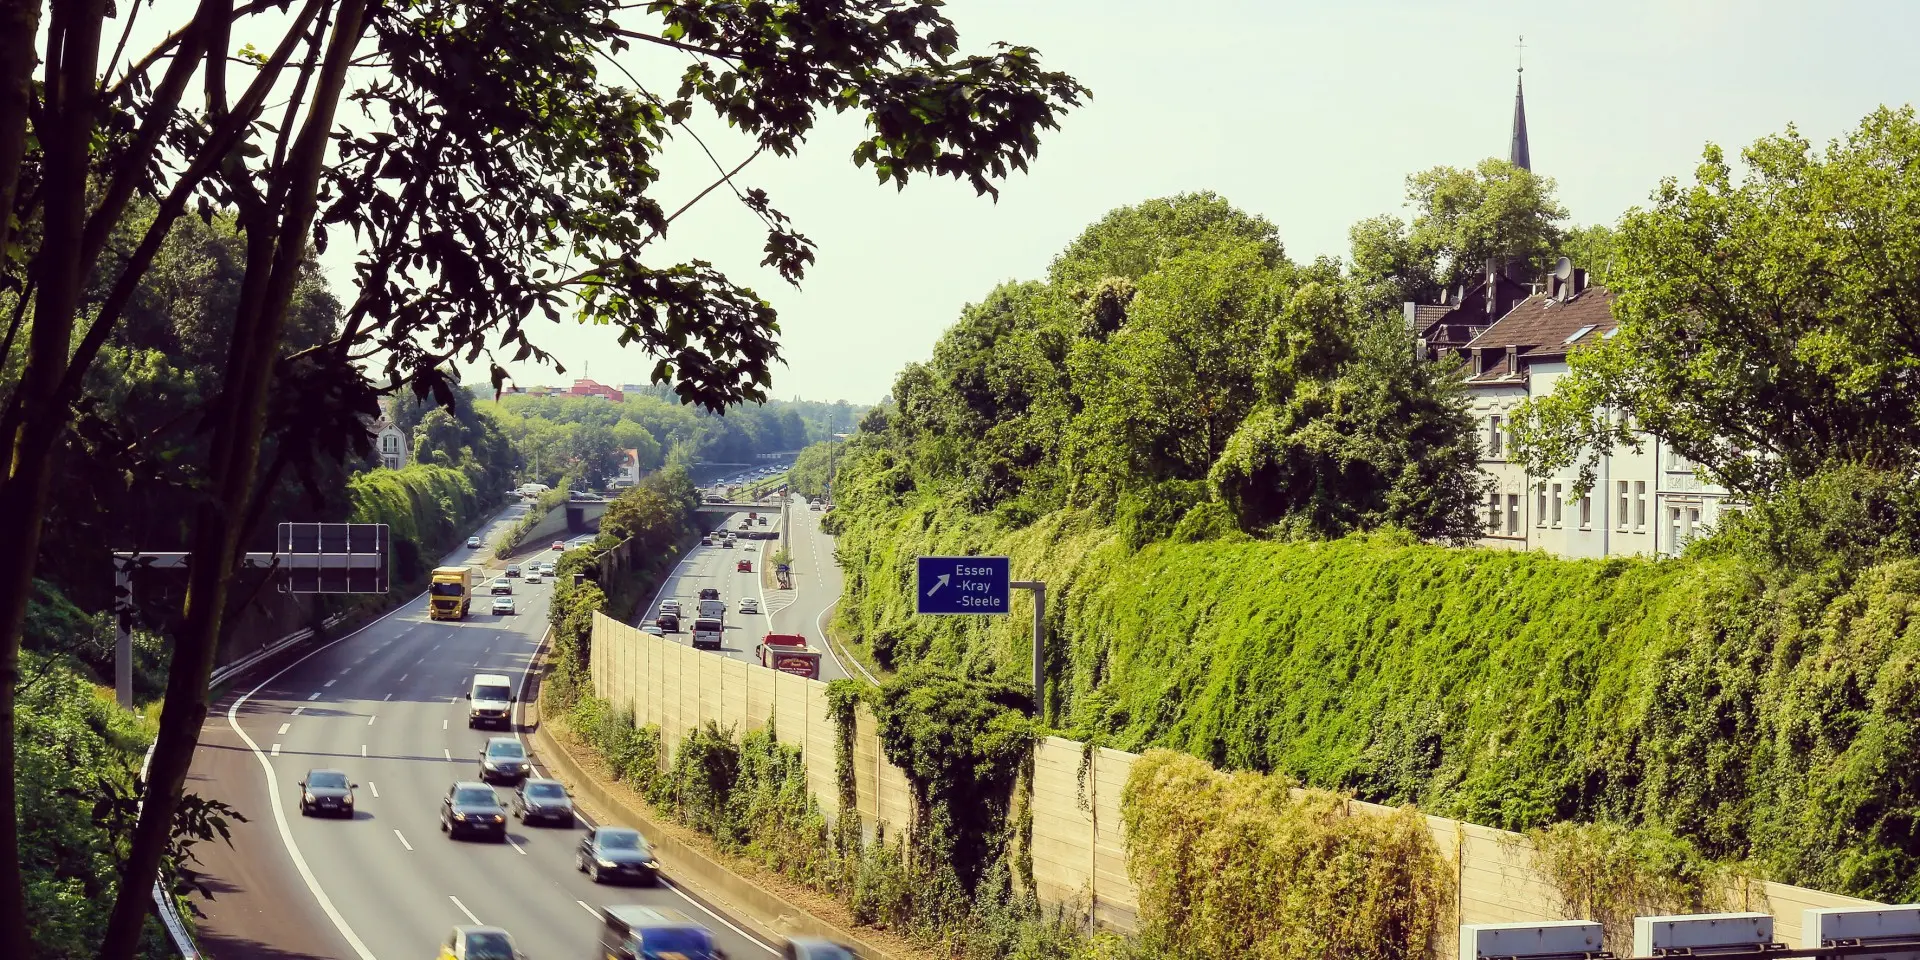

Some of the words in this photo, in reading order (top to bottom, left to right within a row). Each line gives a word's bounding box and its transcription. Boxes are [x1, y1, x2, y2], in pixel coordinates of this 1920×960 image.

[956, 564, 993, 576] Essen
[956, 580, 991, 594] -Kray
[956, 595, 1001, 607] -Steele
